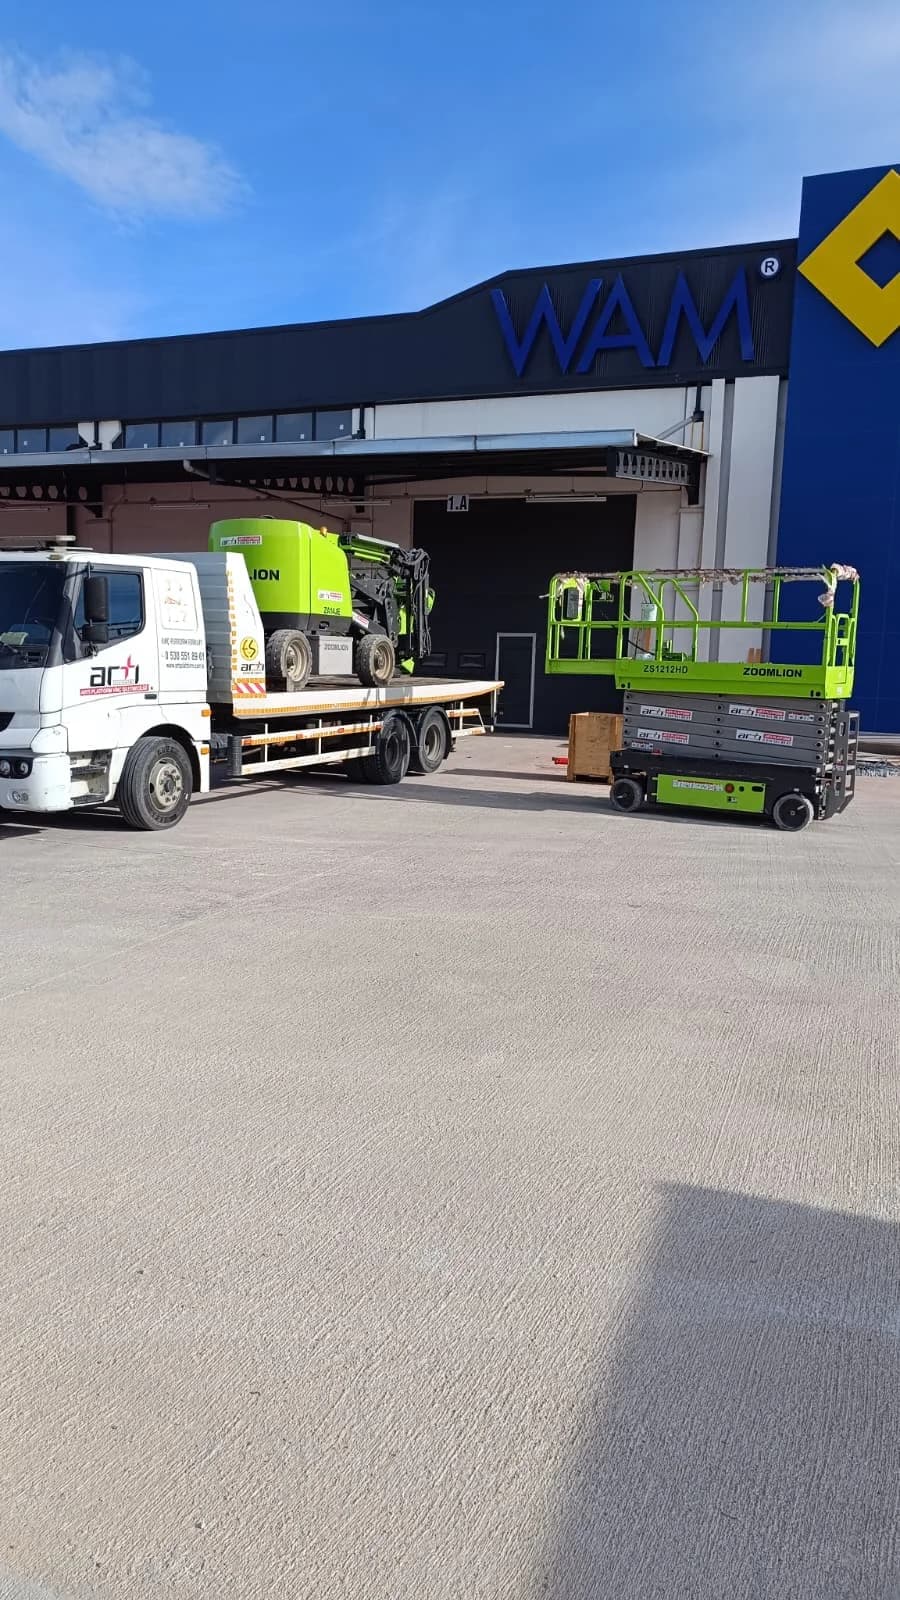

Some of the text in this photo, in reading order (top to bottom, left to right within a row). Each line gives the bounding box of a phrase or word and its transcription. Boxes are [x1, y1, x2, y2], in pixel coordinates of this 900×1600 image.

[490, 265, 755, 377] WAM
[449, 495, 467, 510] 1.A
[643, 664, 689, 674] ZS1212HD
[743, 667, 803, 678] ZOOMLION
